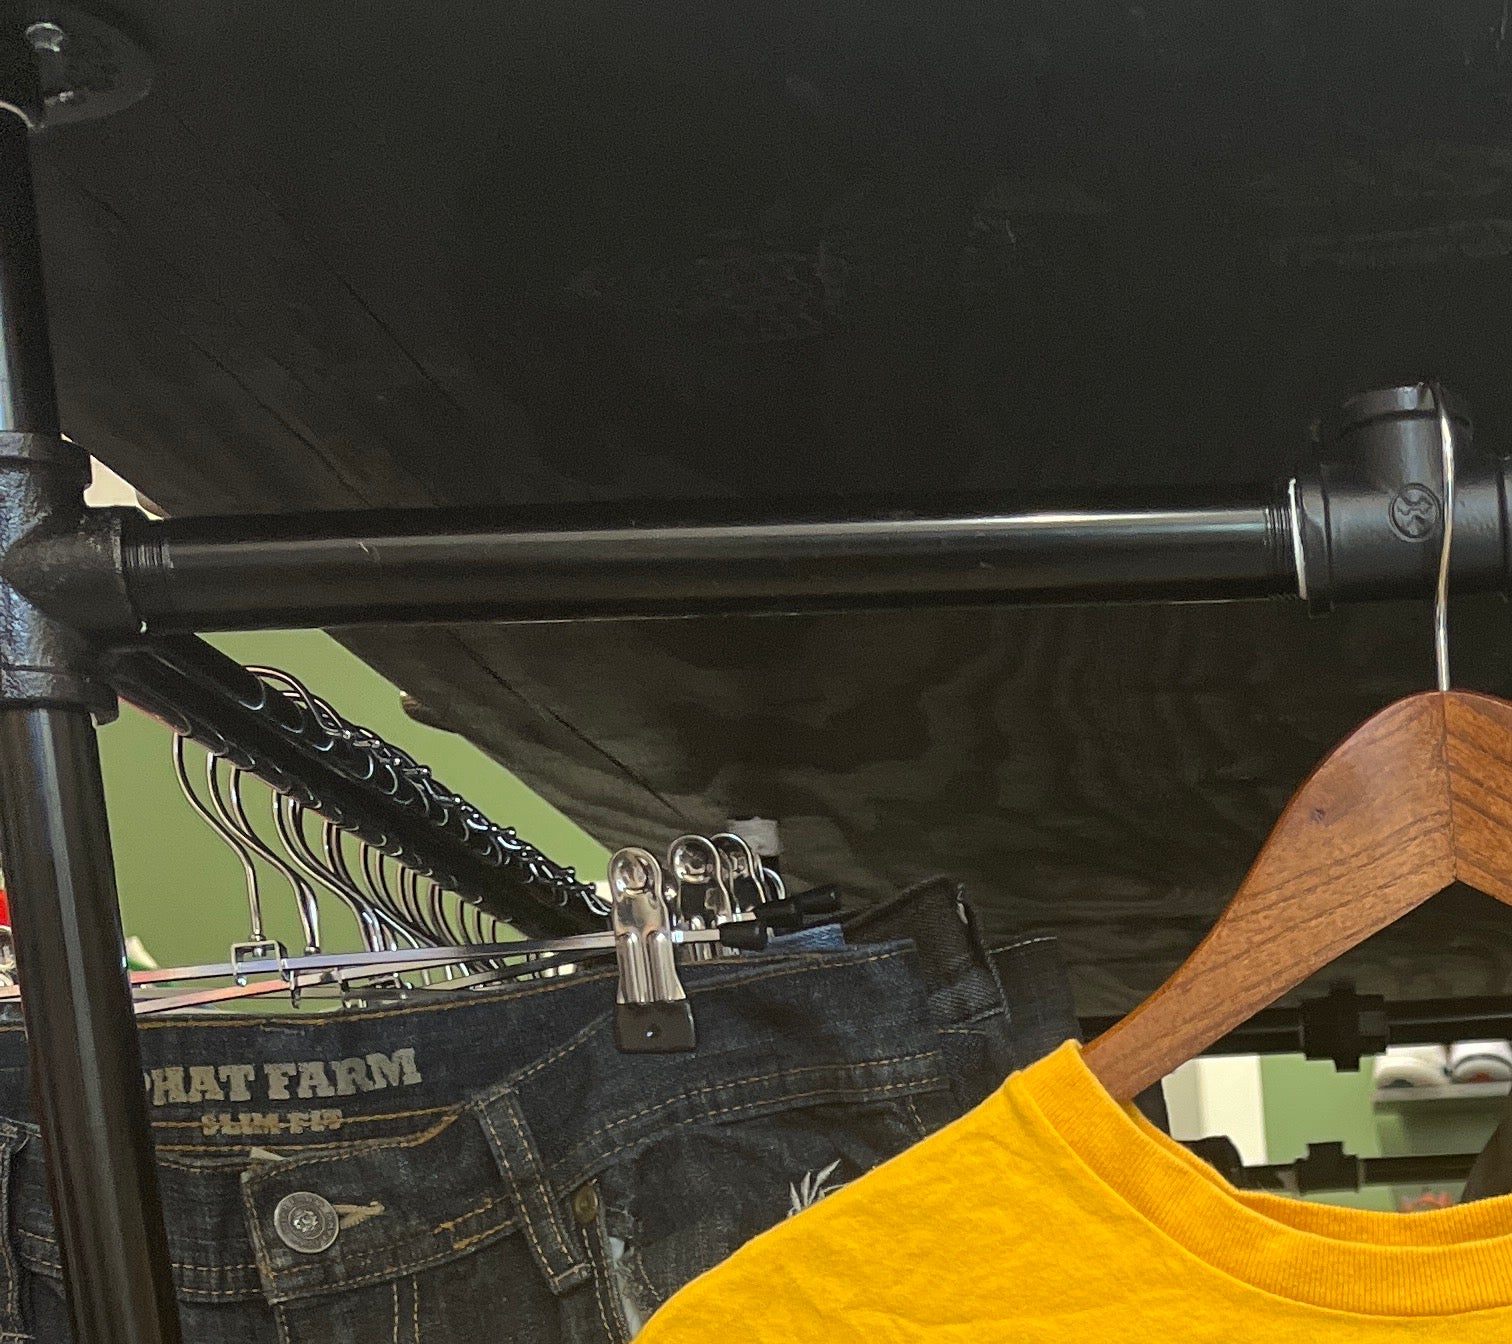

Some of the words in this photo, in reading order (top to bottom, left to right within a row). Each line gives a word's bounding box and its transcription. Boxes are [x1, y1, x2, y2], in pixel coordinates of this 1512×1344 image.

[143, 1064, 256, 1106] HAT
[263, 1047, 423, 1101] FARM
[202, 1112, 282, 1136] SLIM
[287, 1108, 343, 1134] FIT
